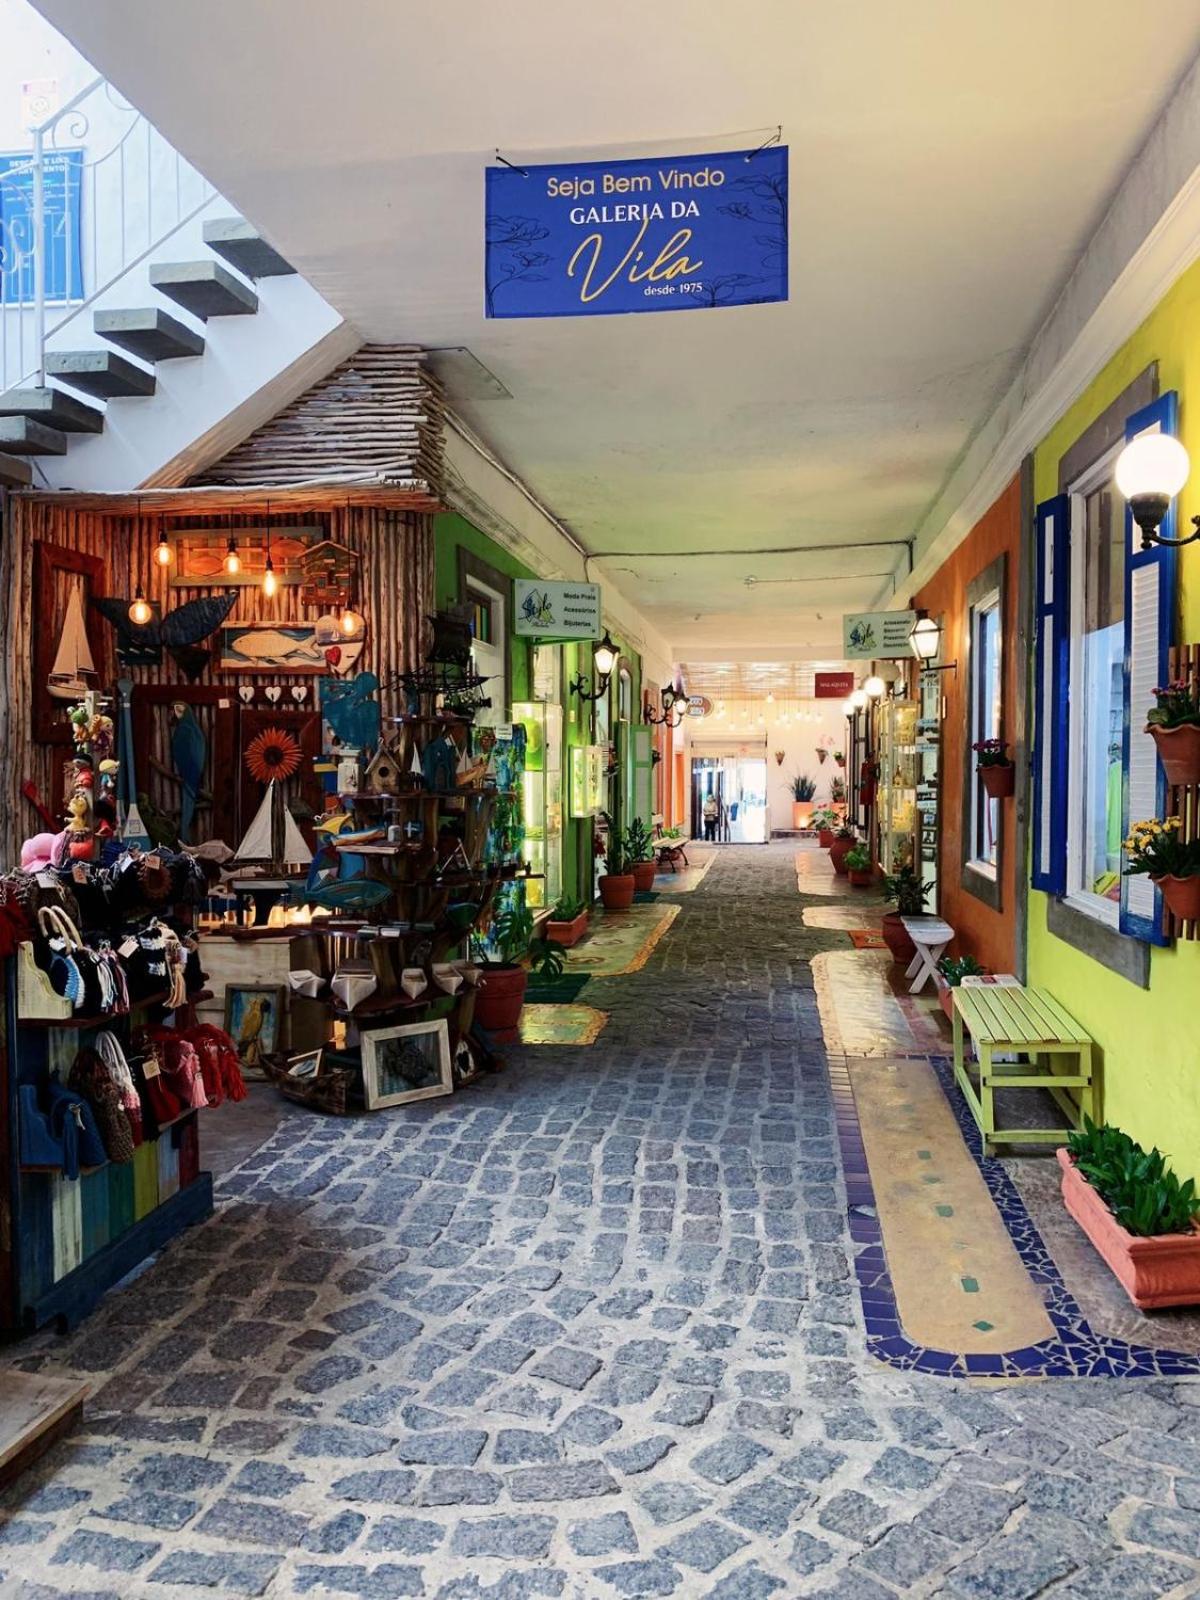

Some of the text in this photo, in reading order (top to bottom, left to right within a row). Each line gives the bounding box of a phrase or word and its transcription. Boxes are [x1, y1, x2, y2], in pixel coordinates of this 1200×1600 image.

[547, 167, 726, 200] Seja Bem Vindo
[569, 200, 701, 225] GALERIA DA
[567, 217, 704, 303] Vila
[643, 282, 704, 297] desde 1975
[563, 592, 596, 601] Moda Praia
